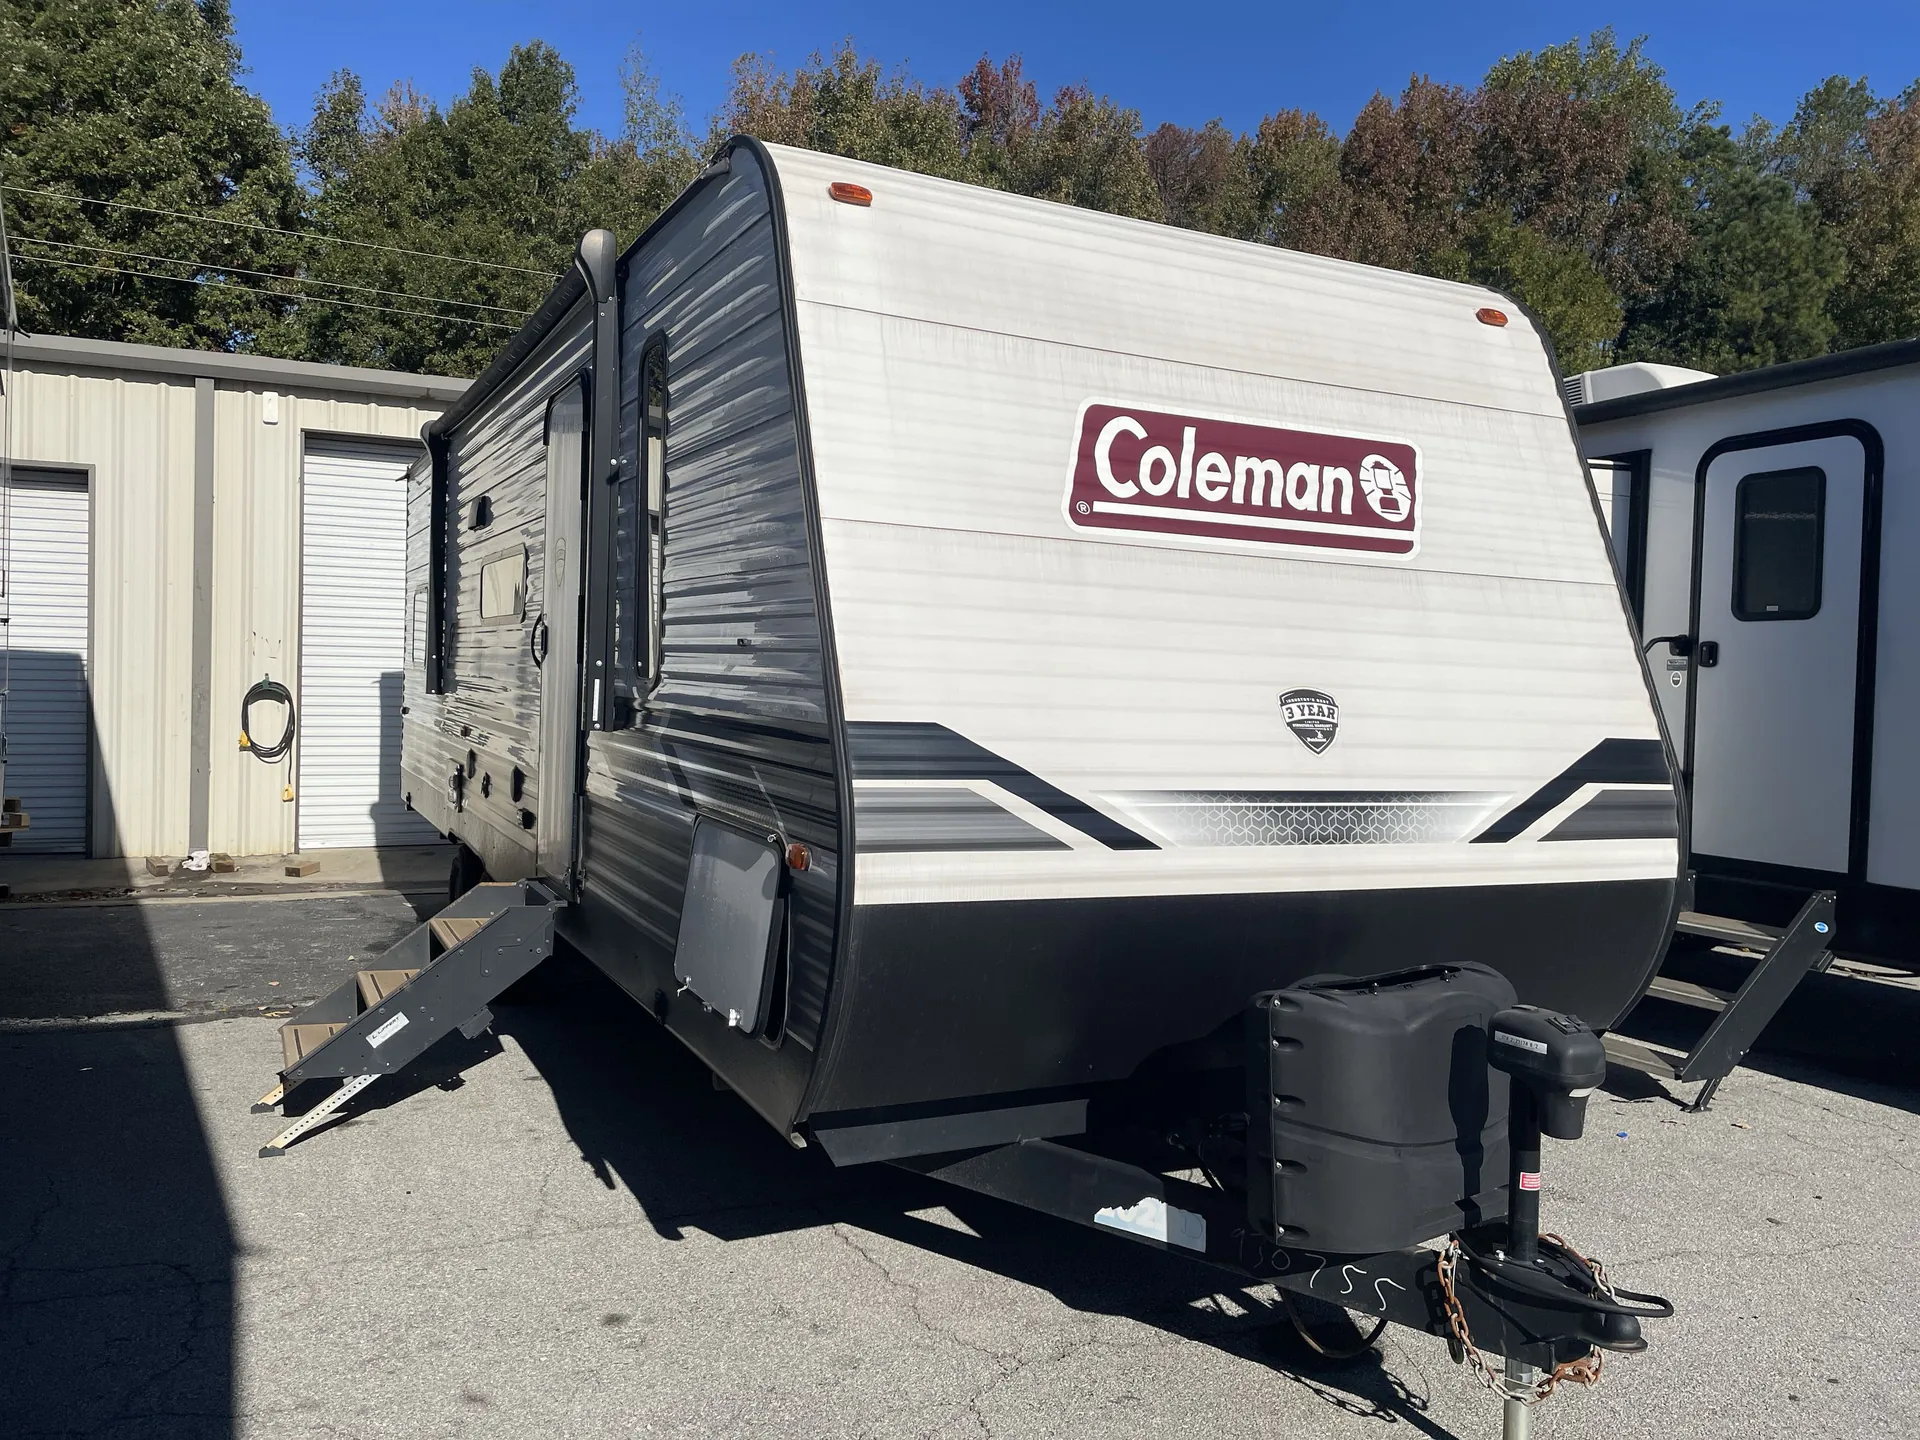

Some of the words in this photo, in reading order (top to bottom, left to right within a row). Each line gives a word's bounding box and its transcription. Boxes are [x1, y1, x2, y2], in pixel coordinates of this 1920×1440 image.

[1094, 415, 1354, 515] Coleman
[1285, 707, 1295, 719] 3
[1296, 704, 1336, 720] YEAR
